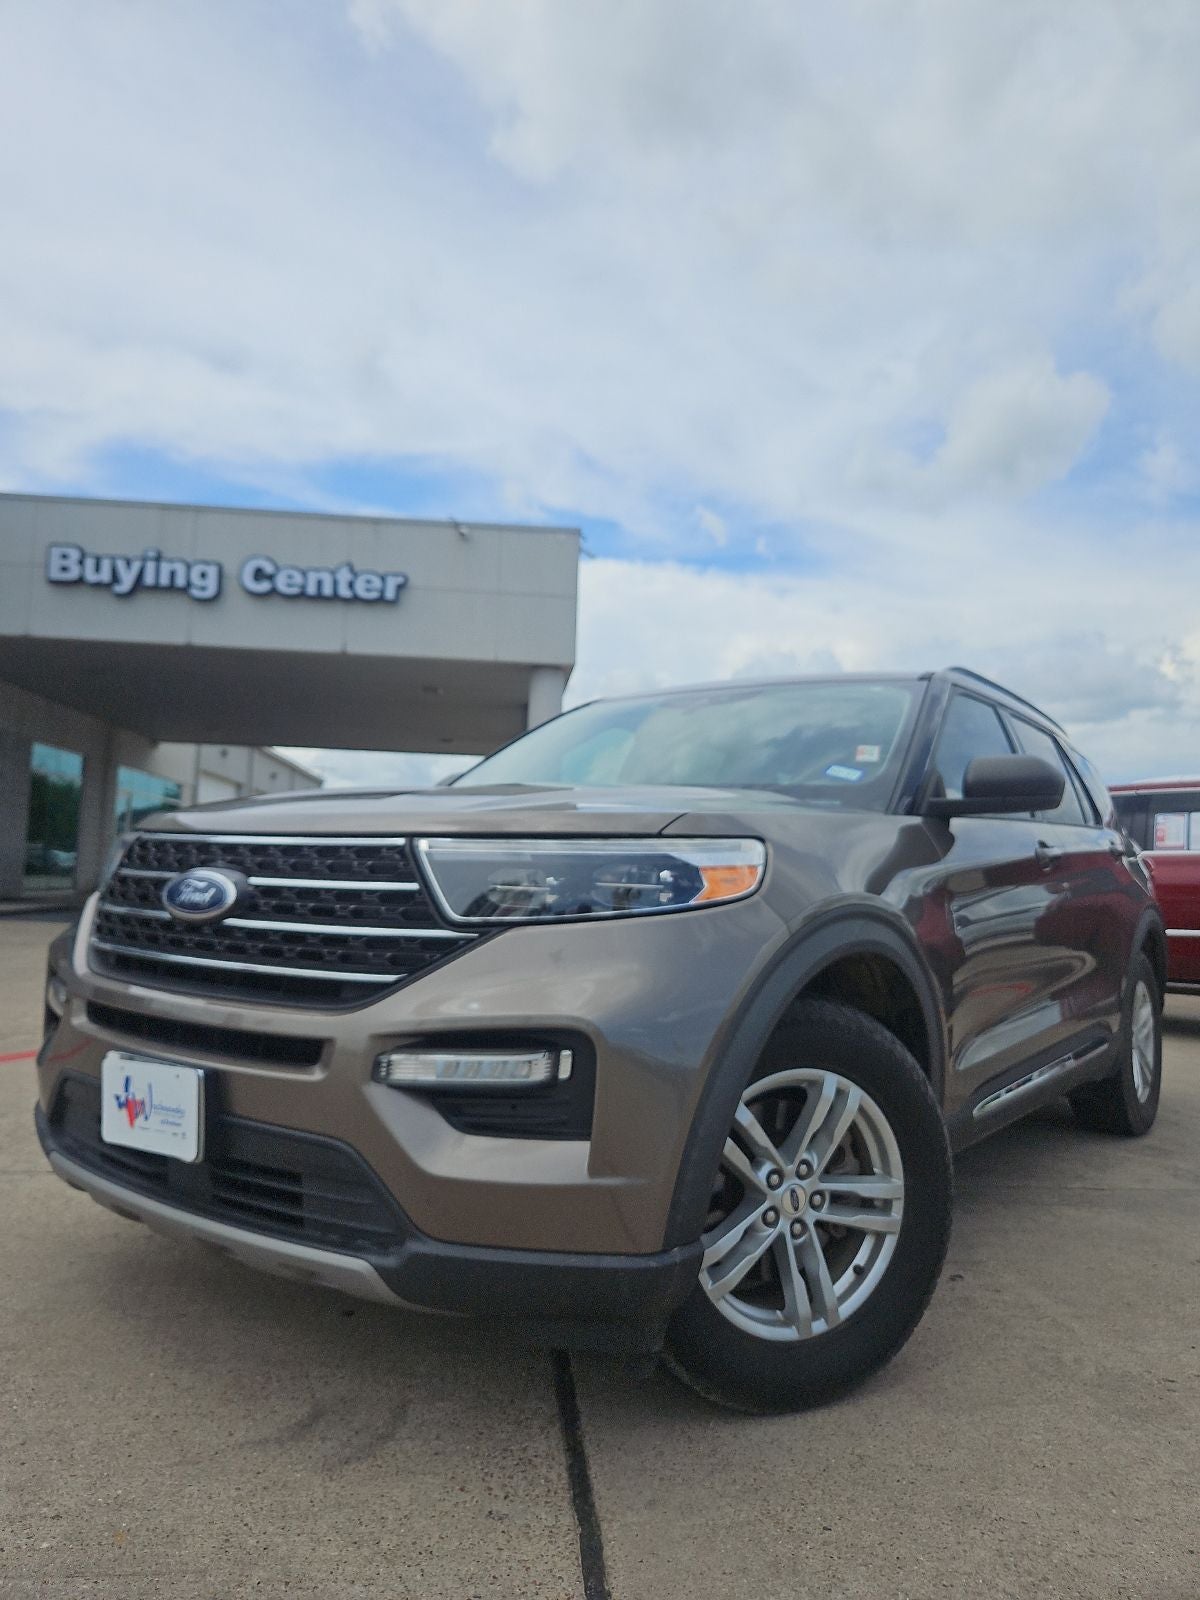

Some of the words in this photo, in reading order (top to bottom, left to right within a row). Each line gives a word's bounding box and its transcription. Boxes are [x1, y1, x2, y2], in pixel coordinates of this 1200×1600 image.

[49, 545, 221, 600] Buying
[240, 556, 407, 602] Center
[176, 878, 217, 906] Ford
